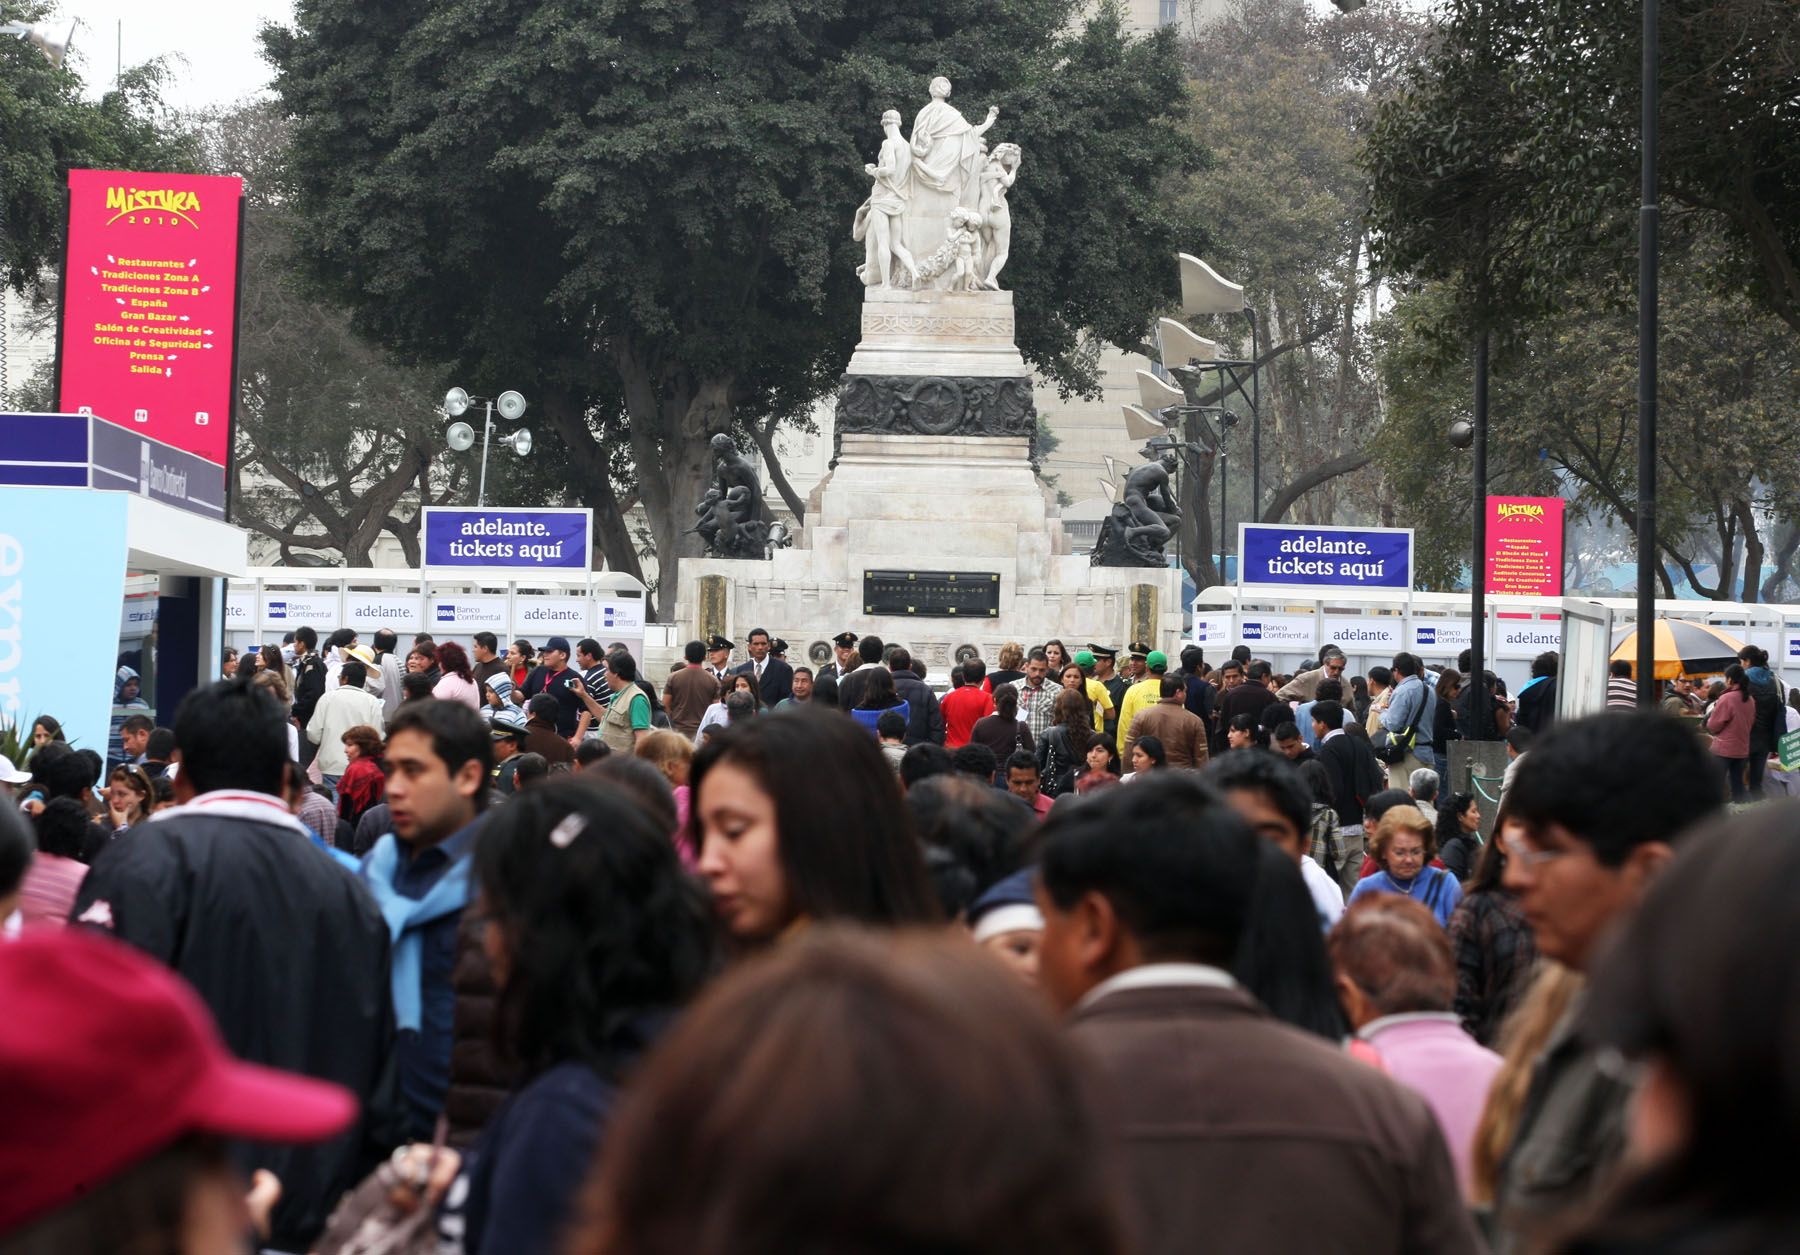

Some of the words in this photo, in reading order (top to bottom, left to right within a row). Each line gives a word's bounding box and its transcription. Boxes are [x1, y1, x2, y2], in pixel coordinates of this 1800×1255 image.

[128, 216, 178, 225] 2010
[118, 258, 184, 268] Restaurantes
[102, 270, 160, 280] Tradiciones
[163, 273, 189, 282] Zona
[102, 284, 160, 293] Tradiciones
[163, 287, 189, 295] Zona
[131, 299, 168, 308] España
[121, 312, 145, 320] Gran
[147, 312, 176, 321] Bazar
[95, 323, 123, 332] Salón
[142, 326, 202, 336] Creatividad
[94, 337, 130, 346] Oficina
[149, 340, 201, 349] Seguridad
[130, 352, 164, 360] Prensa
[131, 365, 162, 374] Salida
[461, 518, 551, 536] adelante.
[450, 540, 513, 557] tickets
[519, 540, 563, 561] aquí
[1280, 536, 1371, 555] adelante.
[1268, 556, 1333, 576] tickets
[1340, 560, 1384, 580] aquí
[355, 605, 413, 618] adelante.
[524, 608, 582, 620] adelante.
[1333, 629, 1392, 641] adelante.
